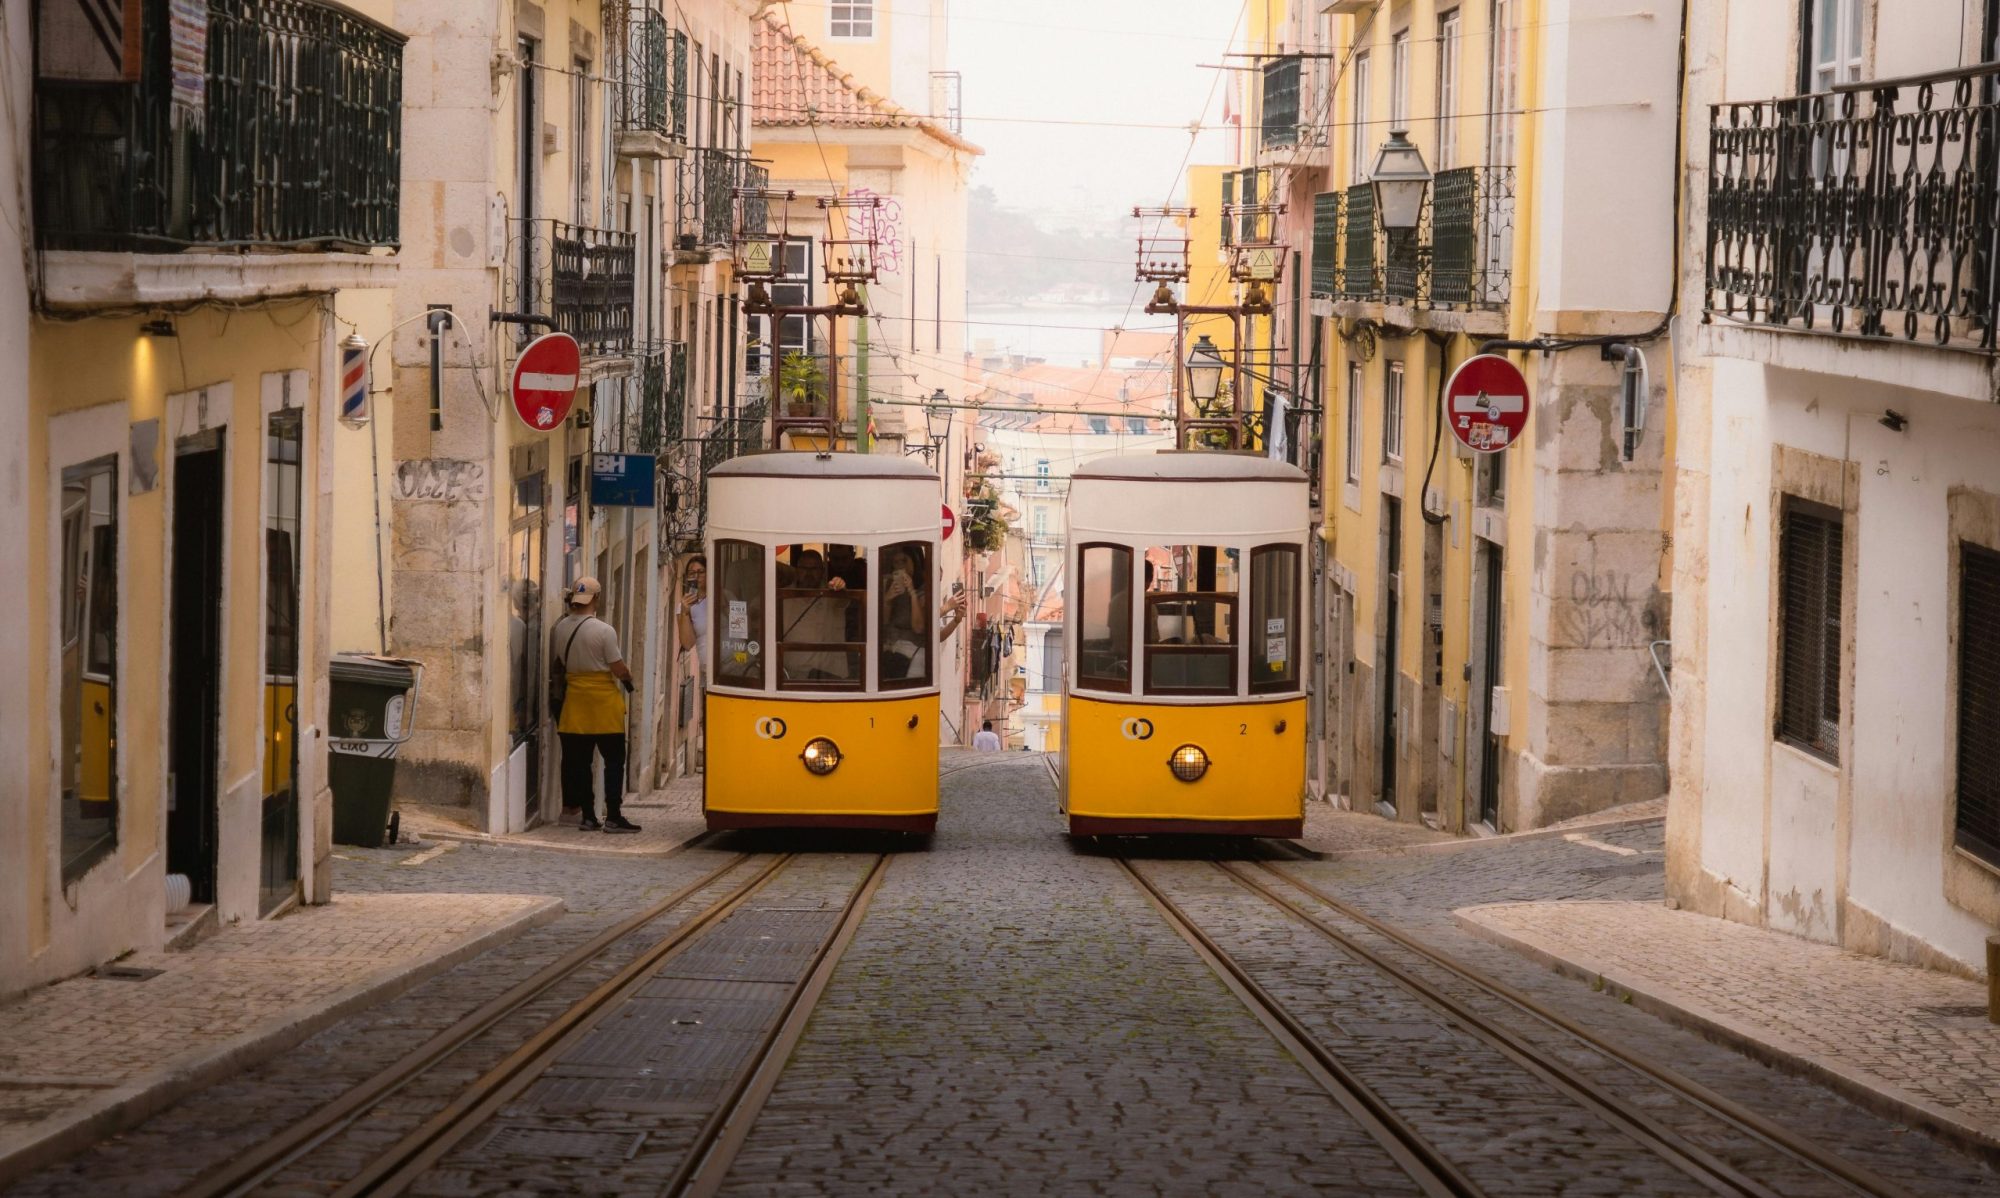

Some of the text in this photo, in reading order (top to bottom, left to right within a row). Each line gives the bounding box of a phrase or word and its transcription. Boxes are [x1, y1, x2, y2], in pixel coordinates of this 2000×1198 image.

[593, 455, 626, 473] BH
[868, 717, 875, 729] 1
[1239, 723, 1247, 735] 2
[340, 742, 369, 753] LIXO
